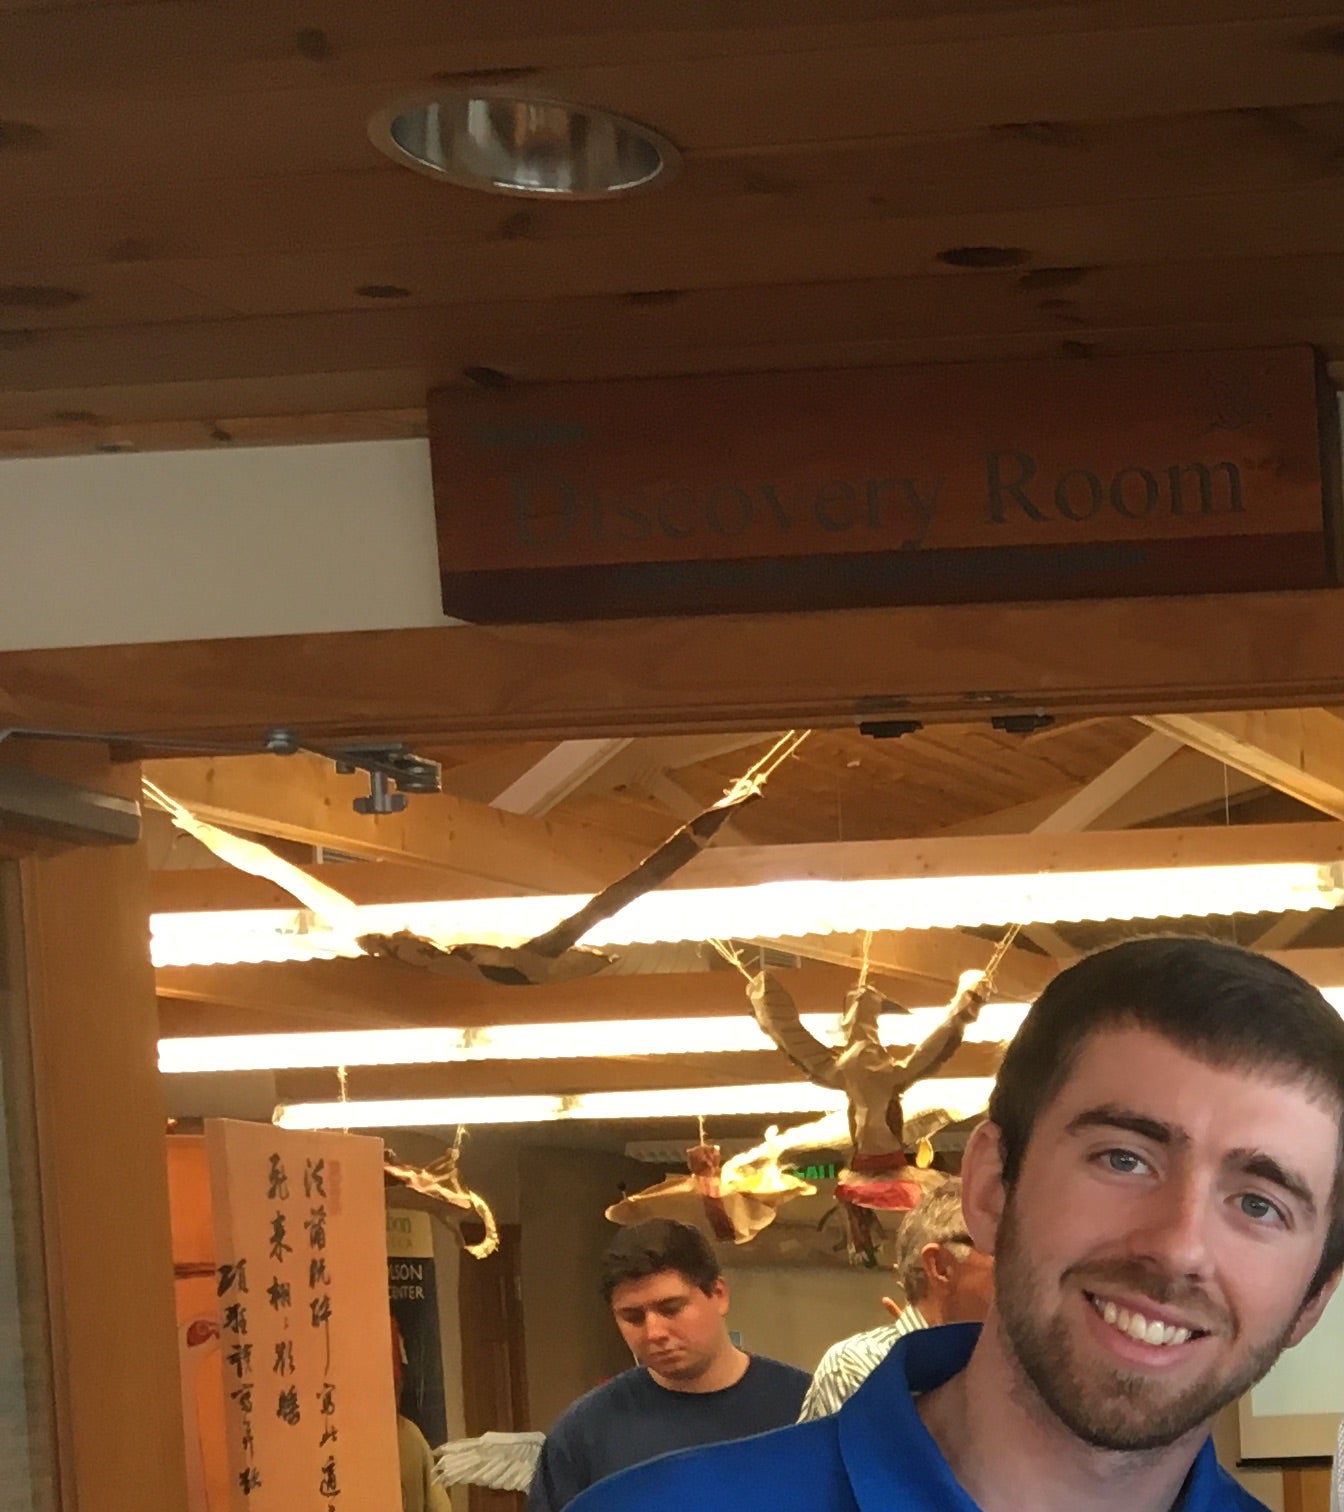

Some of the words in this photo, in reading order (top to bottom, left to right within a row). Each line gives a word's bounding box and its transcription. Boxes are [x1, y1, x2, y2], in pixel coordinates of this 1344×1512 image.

[503, 464, 944, 549] Discovery
[981, 449, 1247, 525] Room
[390, 1264, 423, 1281] LSON
